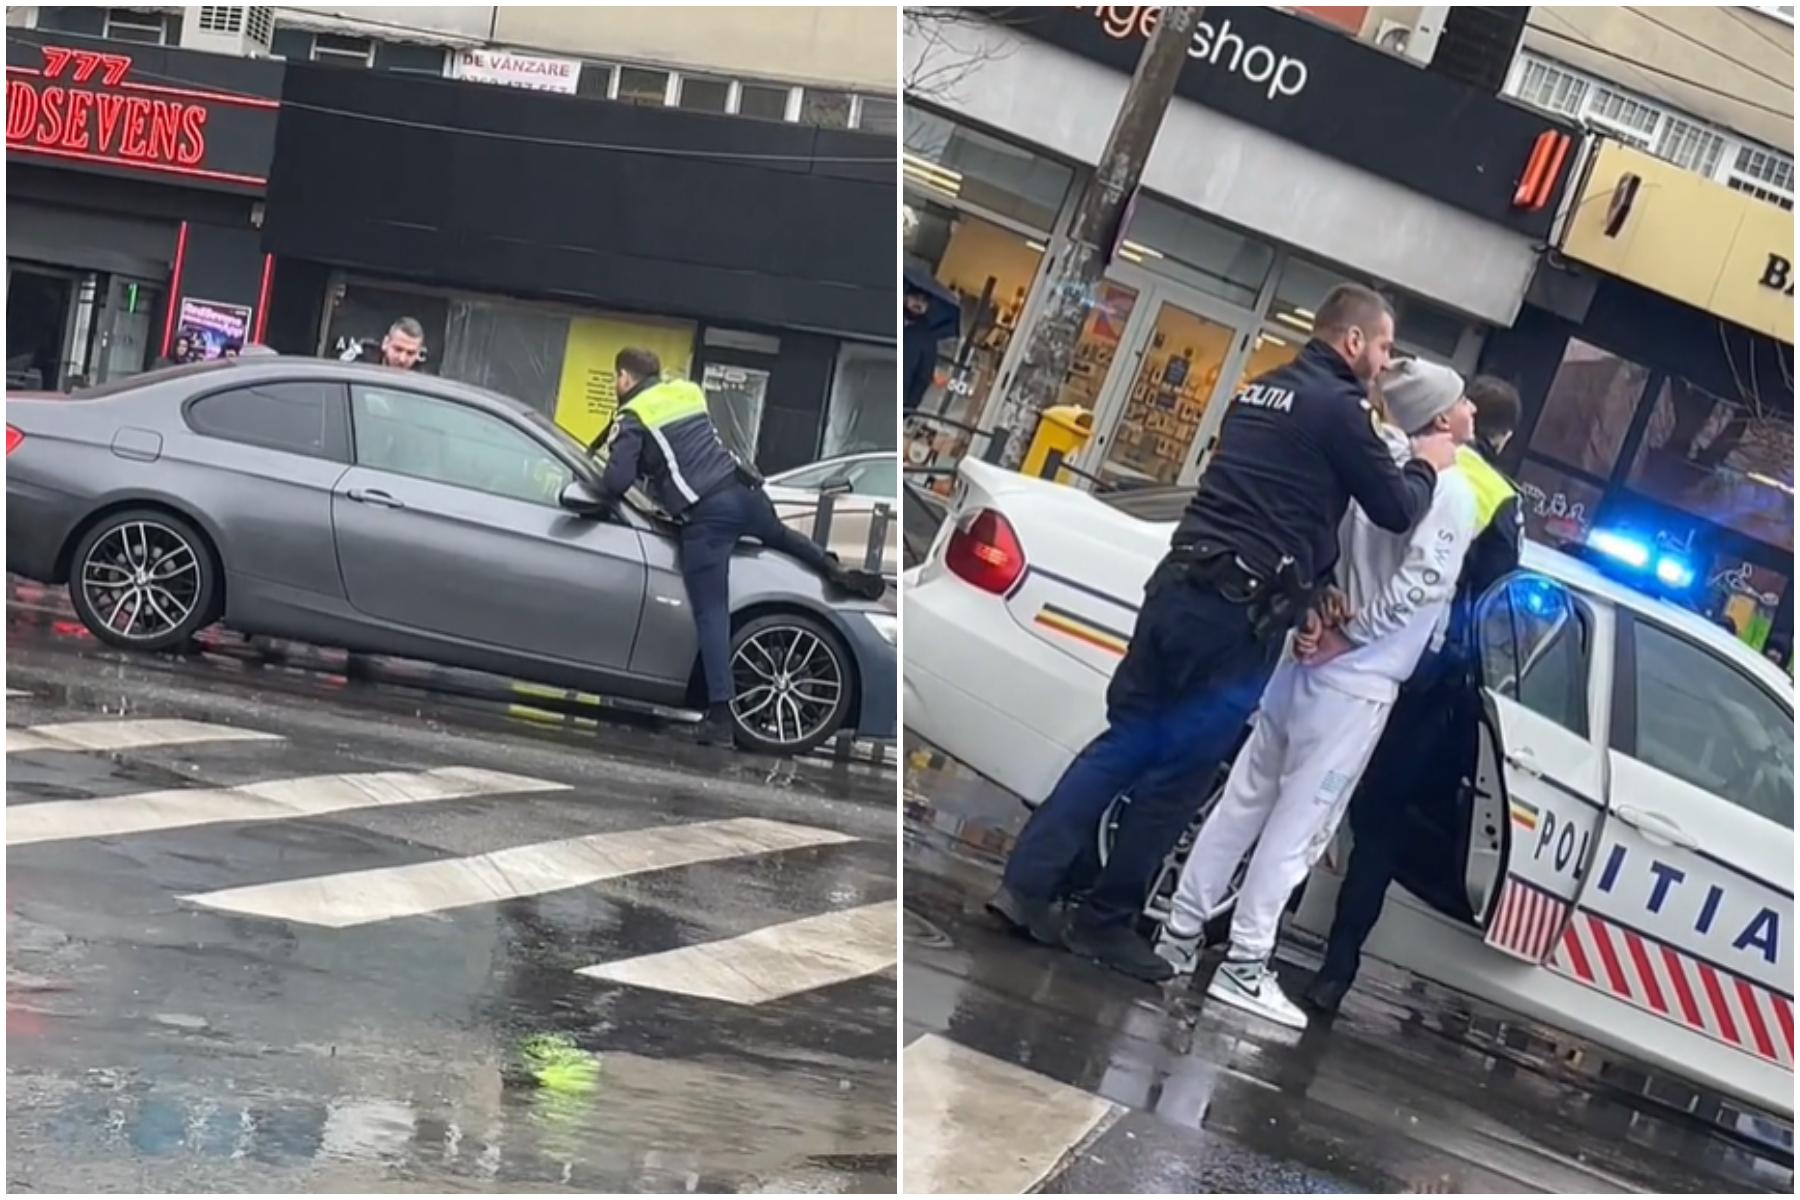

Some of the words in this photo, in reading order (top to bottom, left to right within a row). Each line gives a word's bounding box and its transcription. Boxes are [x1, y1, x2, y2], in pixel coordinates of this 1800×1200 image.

[41, 45, 132, 85] 777
[463, 53, 483, 68] DE
[1187, 19, 1308, 99] shop
[6, 80, 207, 164] DSEVENS
[1757, 252, 1794, 298] B
[1534, 810, 1780, 964] POLITIA
